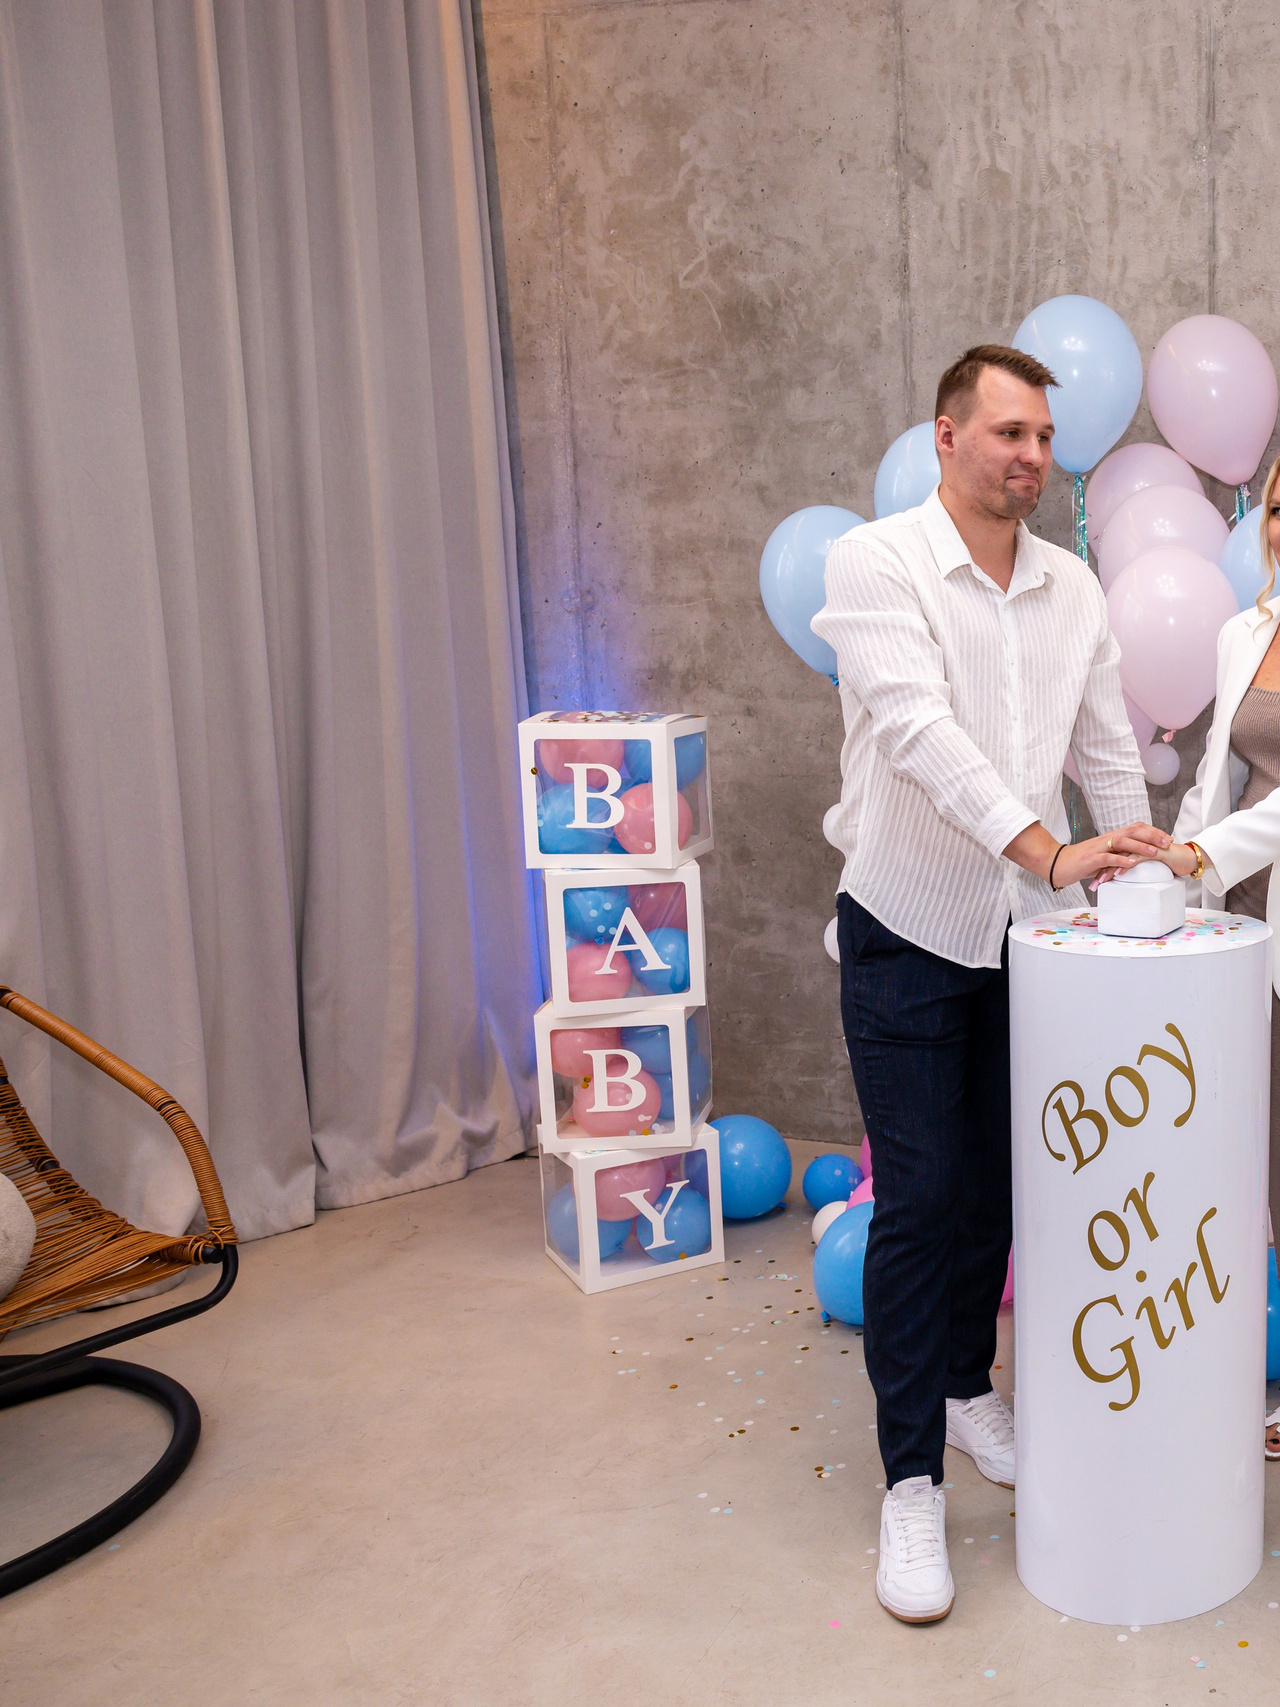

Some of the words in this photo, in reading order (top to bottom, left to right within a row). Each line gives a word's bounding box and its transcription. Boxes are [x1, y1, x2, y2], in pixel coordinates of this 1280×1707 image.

[1041, 1022, 1196, 1174] Boy
[1087, 1172, 1159, 1271] or
[1072, 1207, 1230, 1411] Girl
